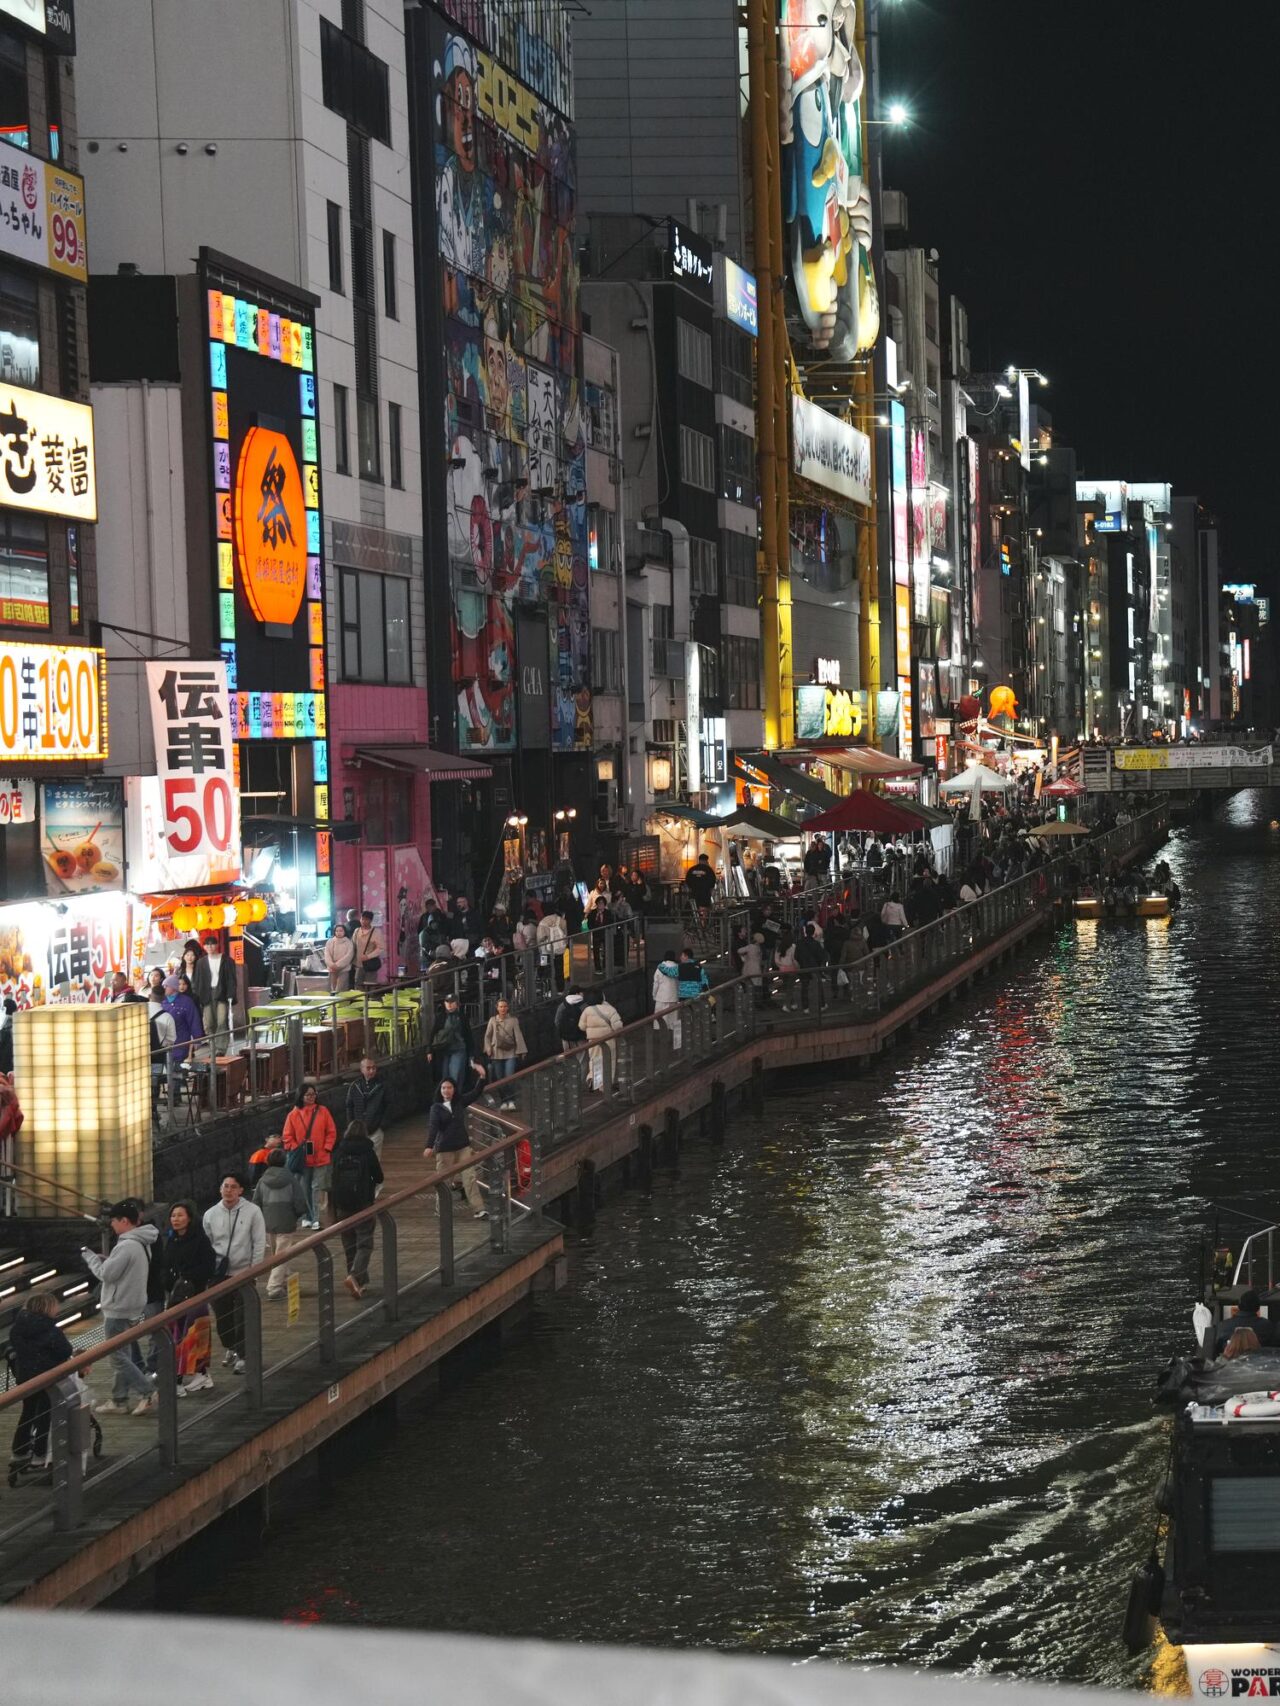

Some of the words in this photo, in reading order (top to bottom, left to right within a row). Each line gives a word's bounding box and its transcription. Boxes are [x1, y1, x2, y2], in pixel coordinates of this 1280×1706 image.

[41, 434, 89, 497] 菱富
[39, 658, 94, 749] 190
[158, 669, 227, 774] 伝串
[164, 776, 233, 853] 50
[1231, 1667, 1280, 1677] WONDER
